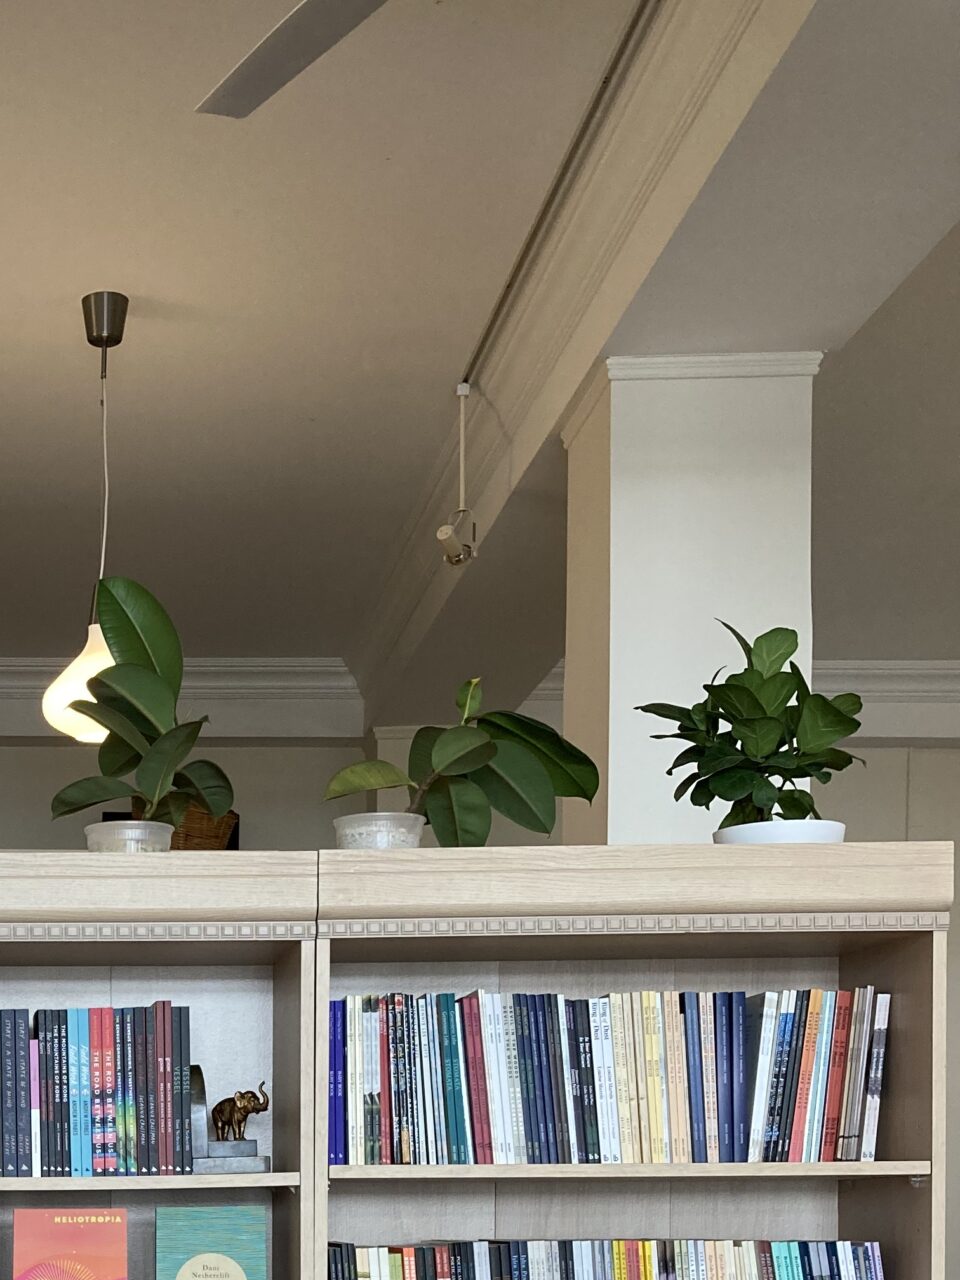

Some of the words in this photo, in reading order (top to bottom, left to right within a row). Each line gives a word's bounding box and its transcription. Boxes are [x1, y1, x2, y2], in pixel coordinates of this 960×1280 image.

[104, 1050, 112, 1067] THE
[61, 1075, 67, 1083] OF
[105, 1070, 113, 1094] ROAD
[182, 1065, 190, 1094] VESSEL
[452, 1057, 460, 1090] STOMATA
[105, 1097, 114, 1139] BETWEEN
[107, 1141, 114, 1153] US
[54, 1215, 122, 1224] HELIOTROPIA
